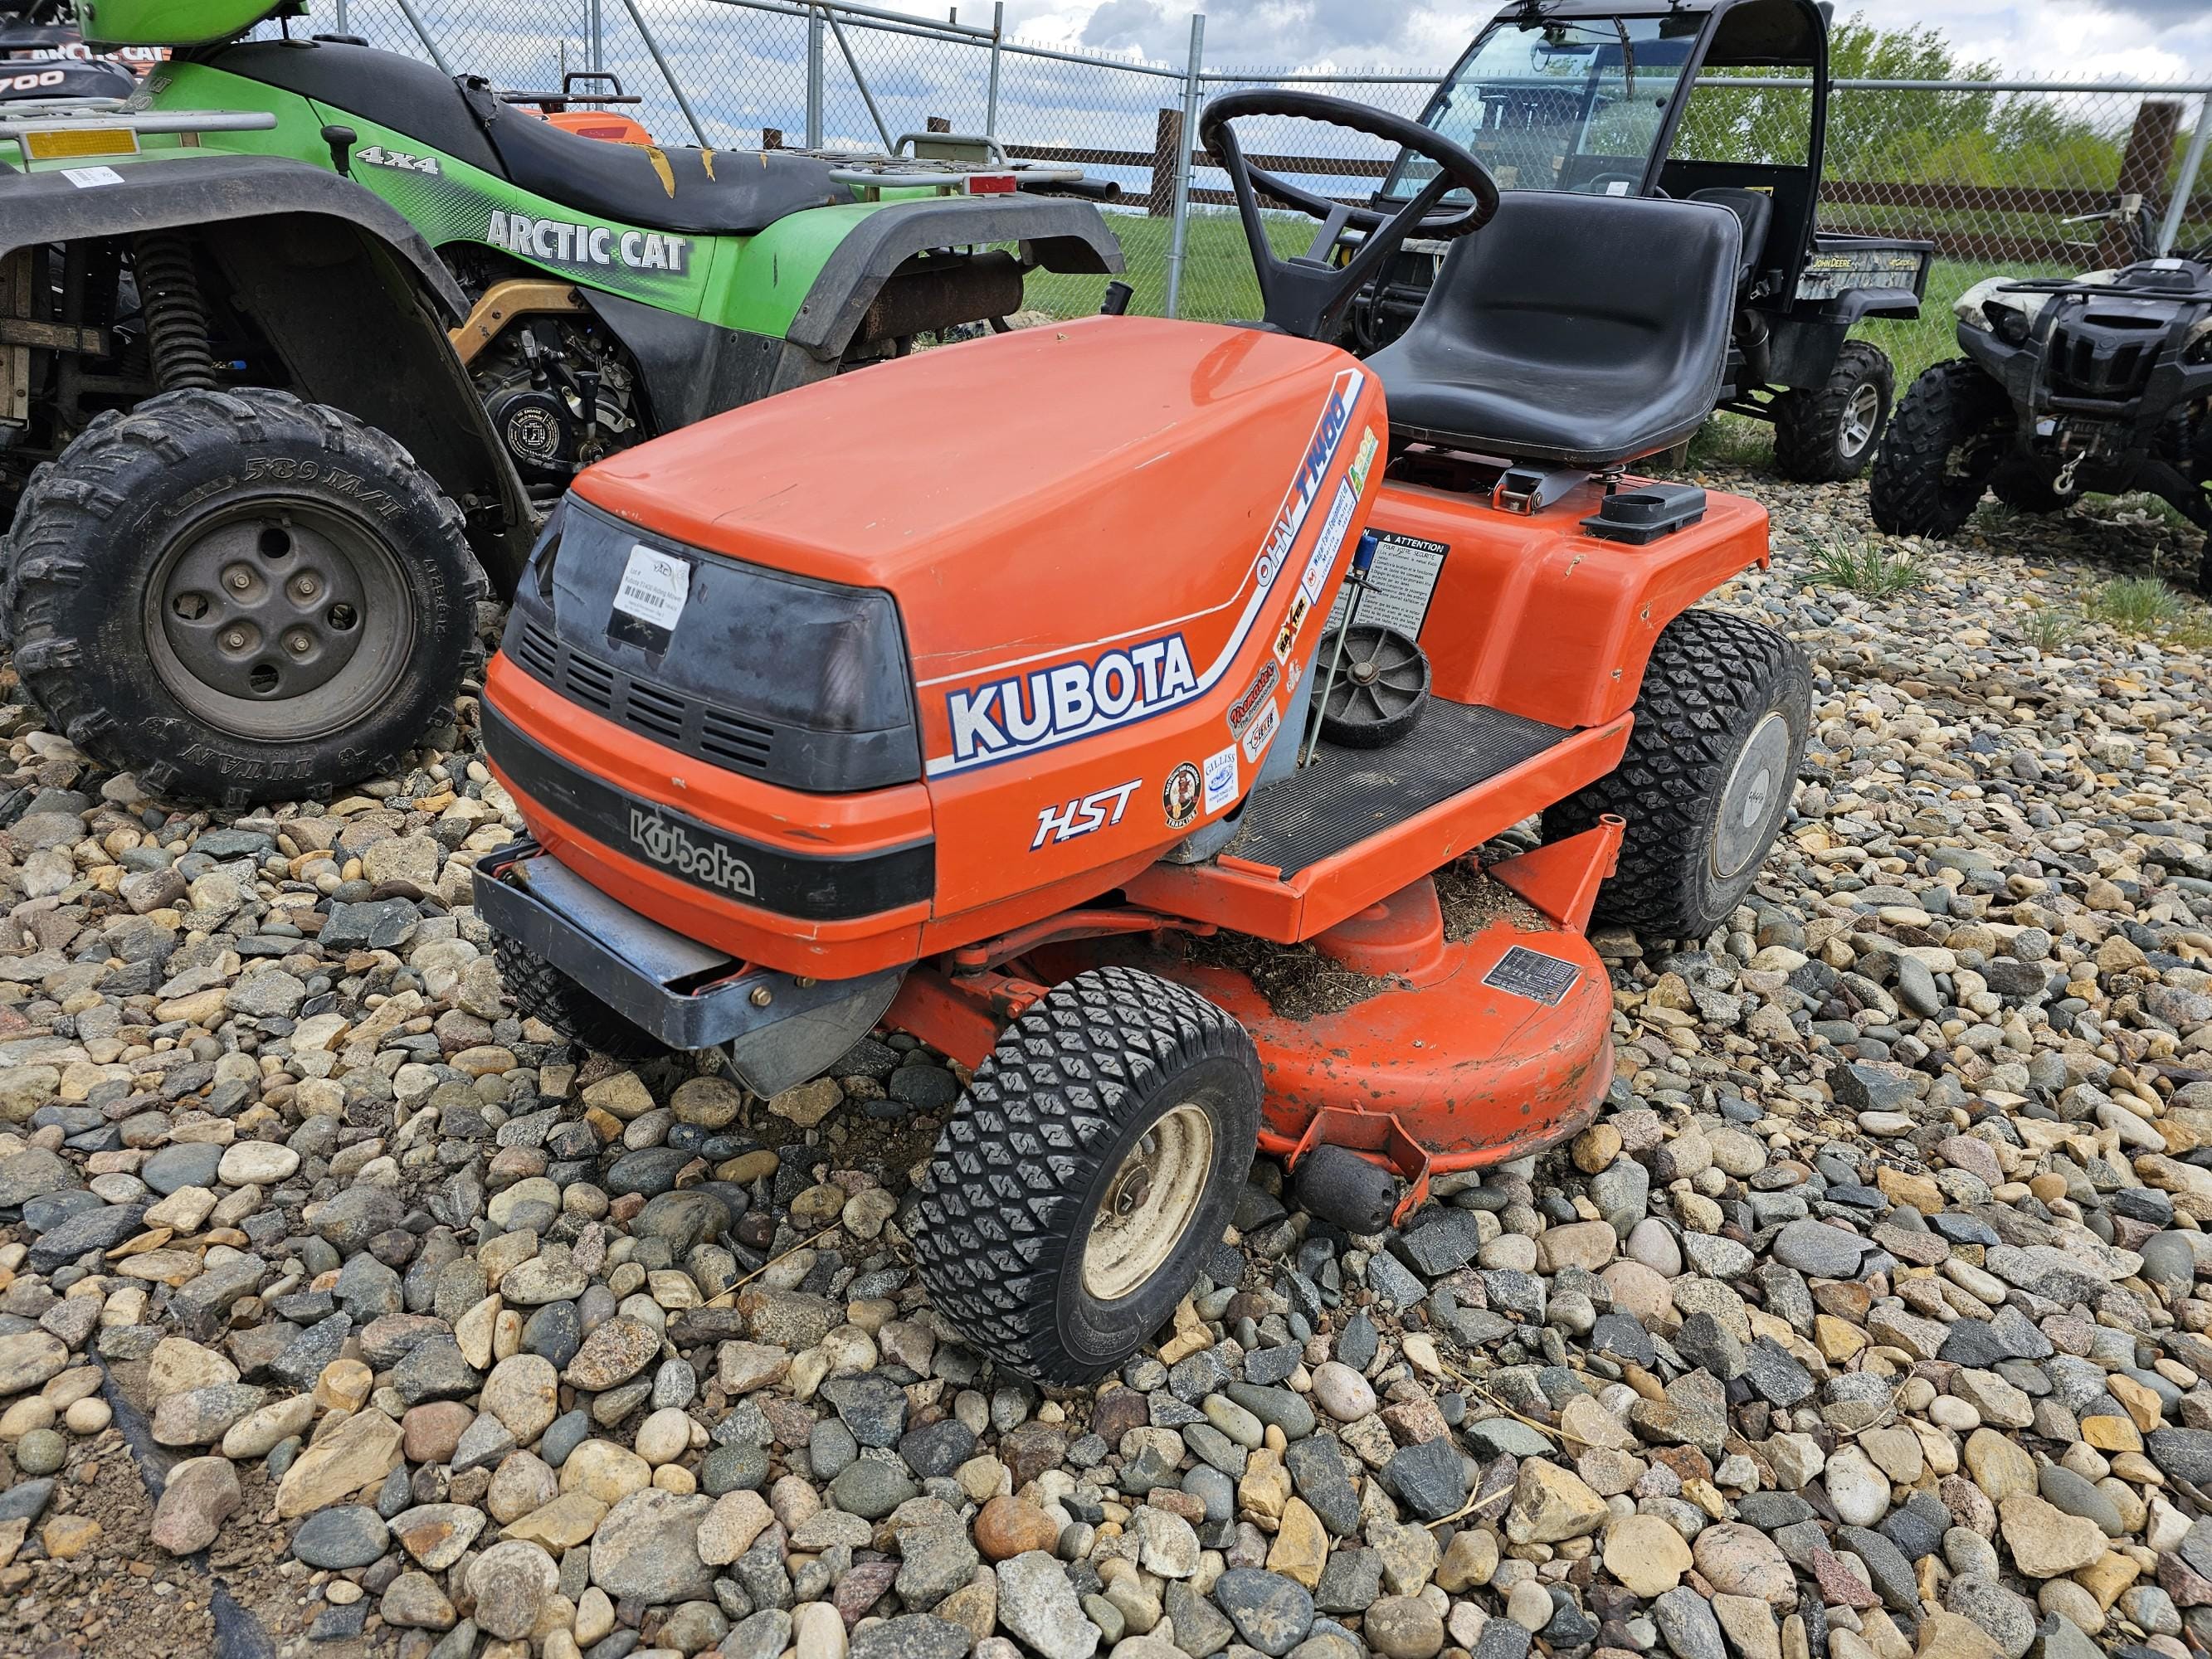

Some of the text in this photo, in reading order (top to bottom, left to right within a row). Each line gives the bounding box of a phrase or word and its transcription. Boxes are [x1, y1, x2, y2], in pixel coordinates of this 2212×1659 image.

[0, 71, 65, 95] 700
[486, 210, 687, 270] ARCTIC CAT
[1813, 258, 1851, 268] JOHN DEERE
[244, 457, 407, 518] 589 M/T
[1256, 391, 1346, 587] OHV T1400
[1395, 536, 1444, 553] ATTENTION
[1279, 597, 1305, 654] BAXTER
[948, 635, 1198, 761] KUBOTA
[178, 744, 313, 781] TITAN
[1030, 778, 1143, 851] HST
[631, 809, 756, 897] Kubota
